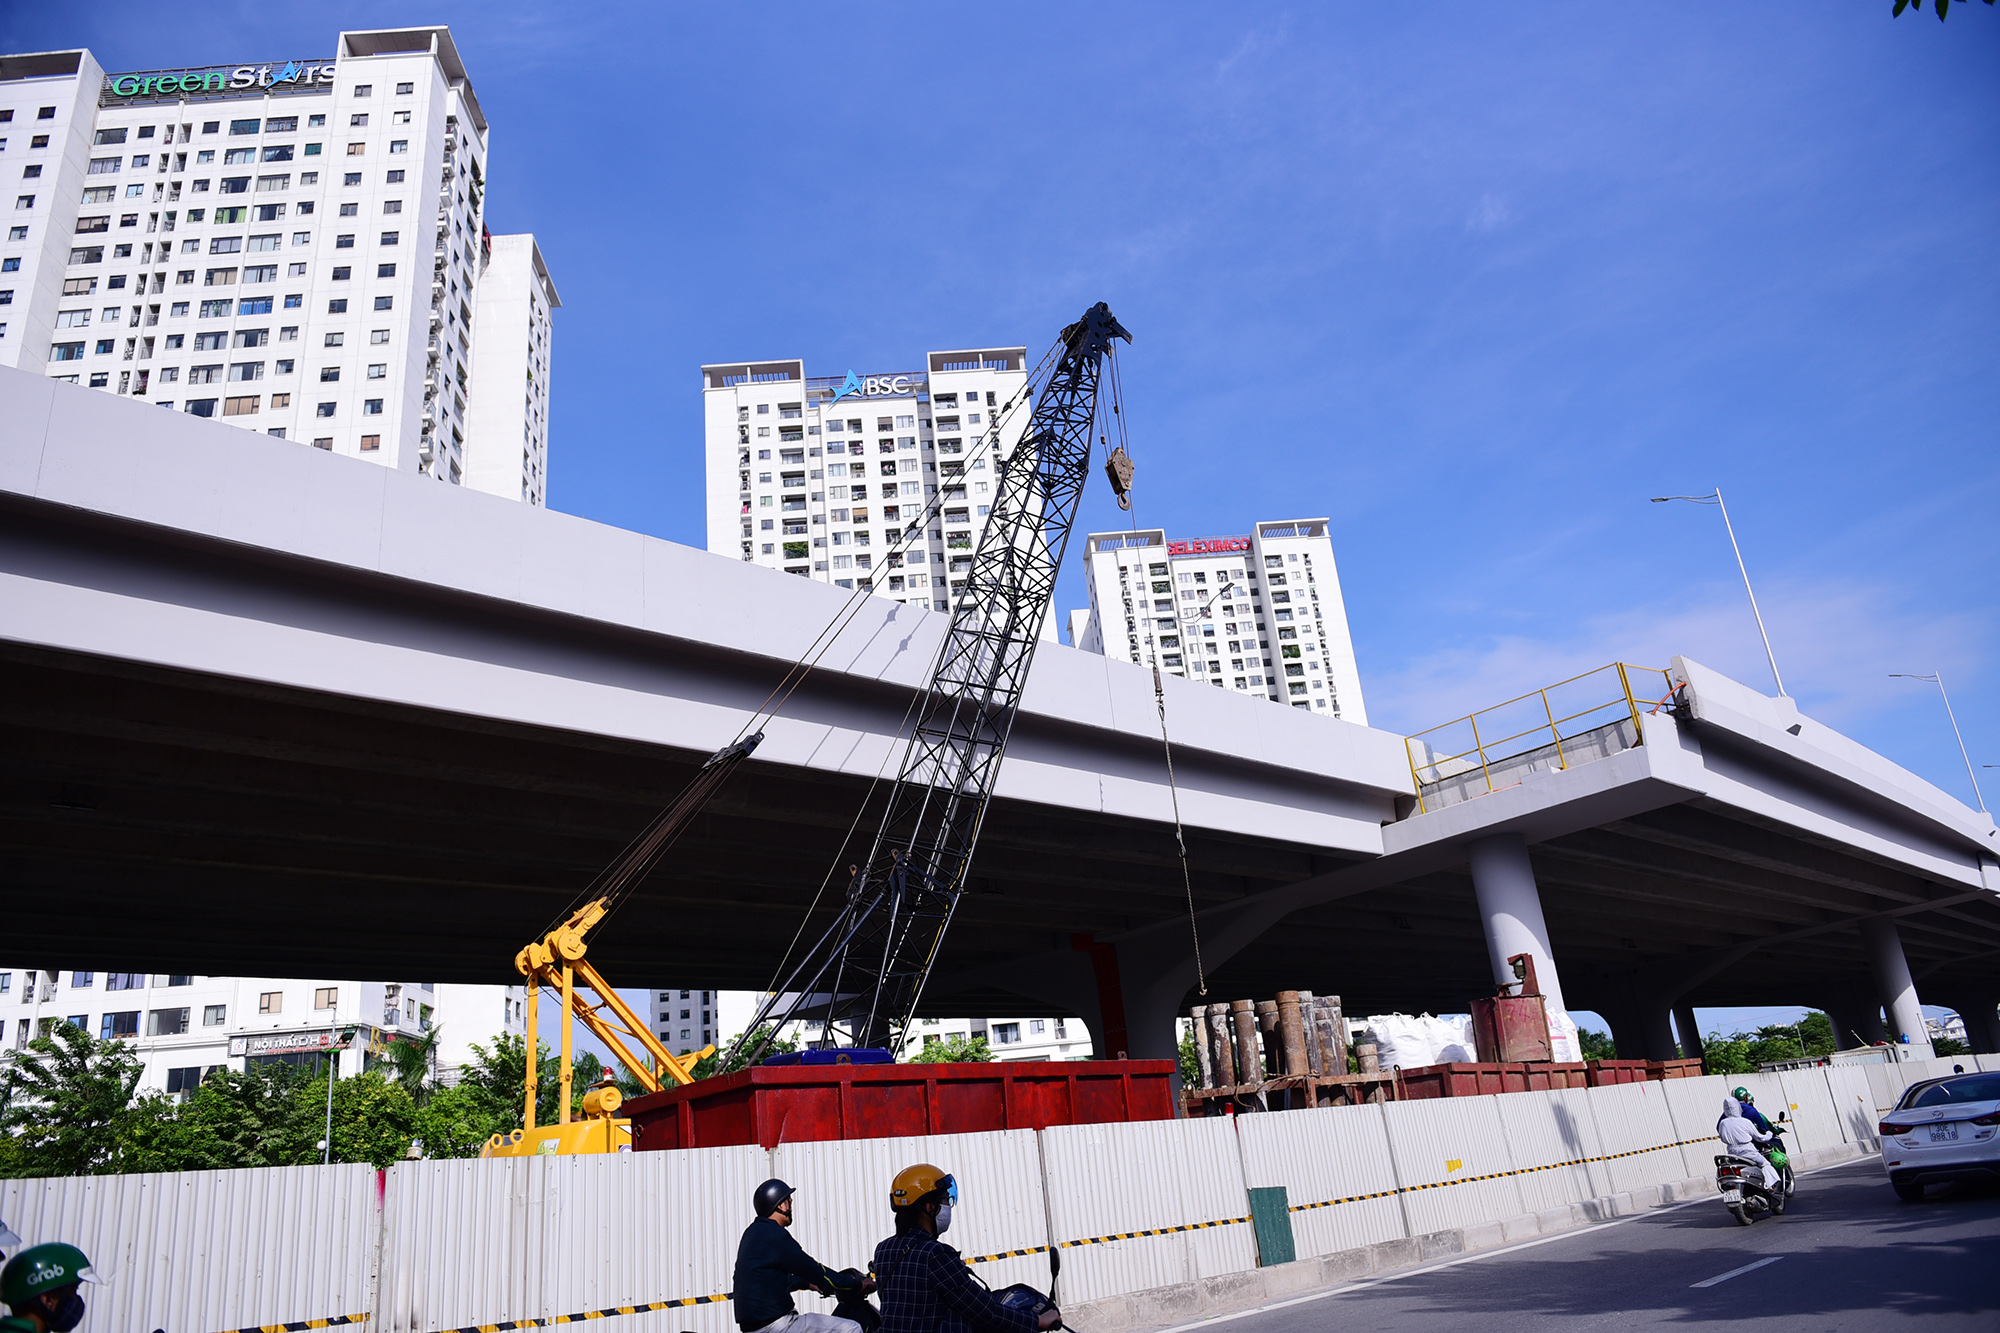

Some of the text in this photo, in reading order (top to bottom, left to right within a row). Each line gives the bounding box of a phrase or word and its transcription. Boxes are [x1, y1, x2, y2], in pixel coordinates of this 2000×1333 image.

[112, 72, 224, 96] Green
[1166, 537, 1251, 556] GELEXIMCO
[27, 1264, 65, 1286] Grab
